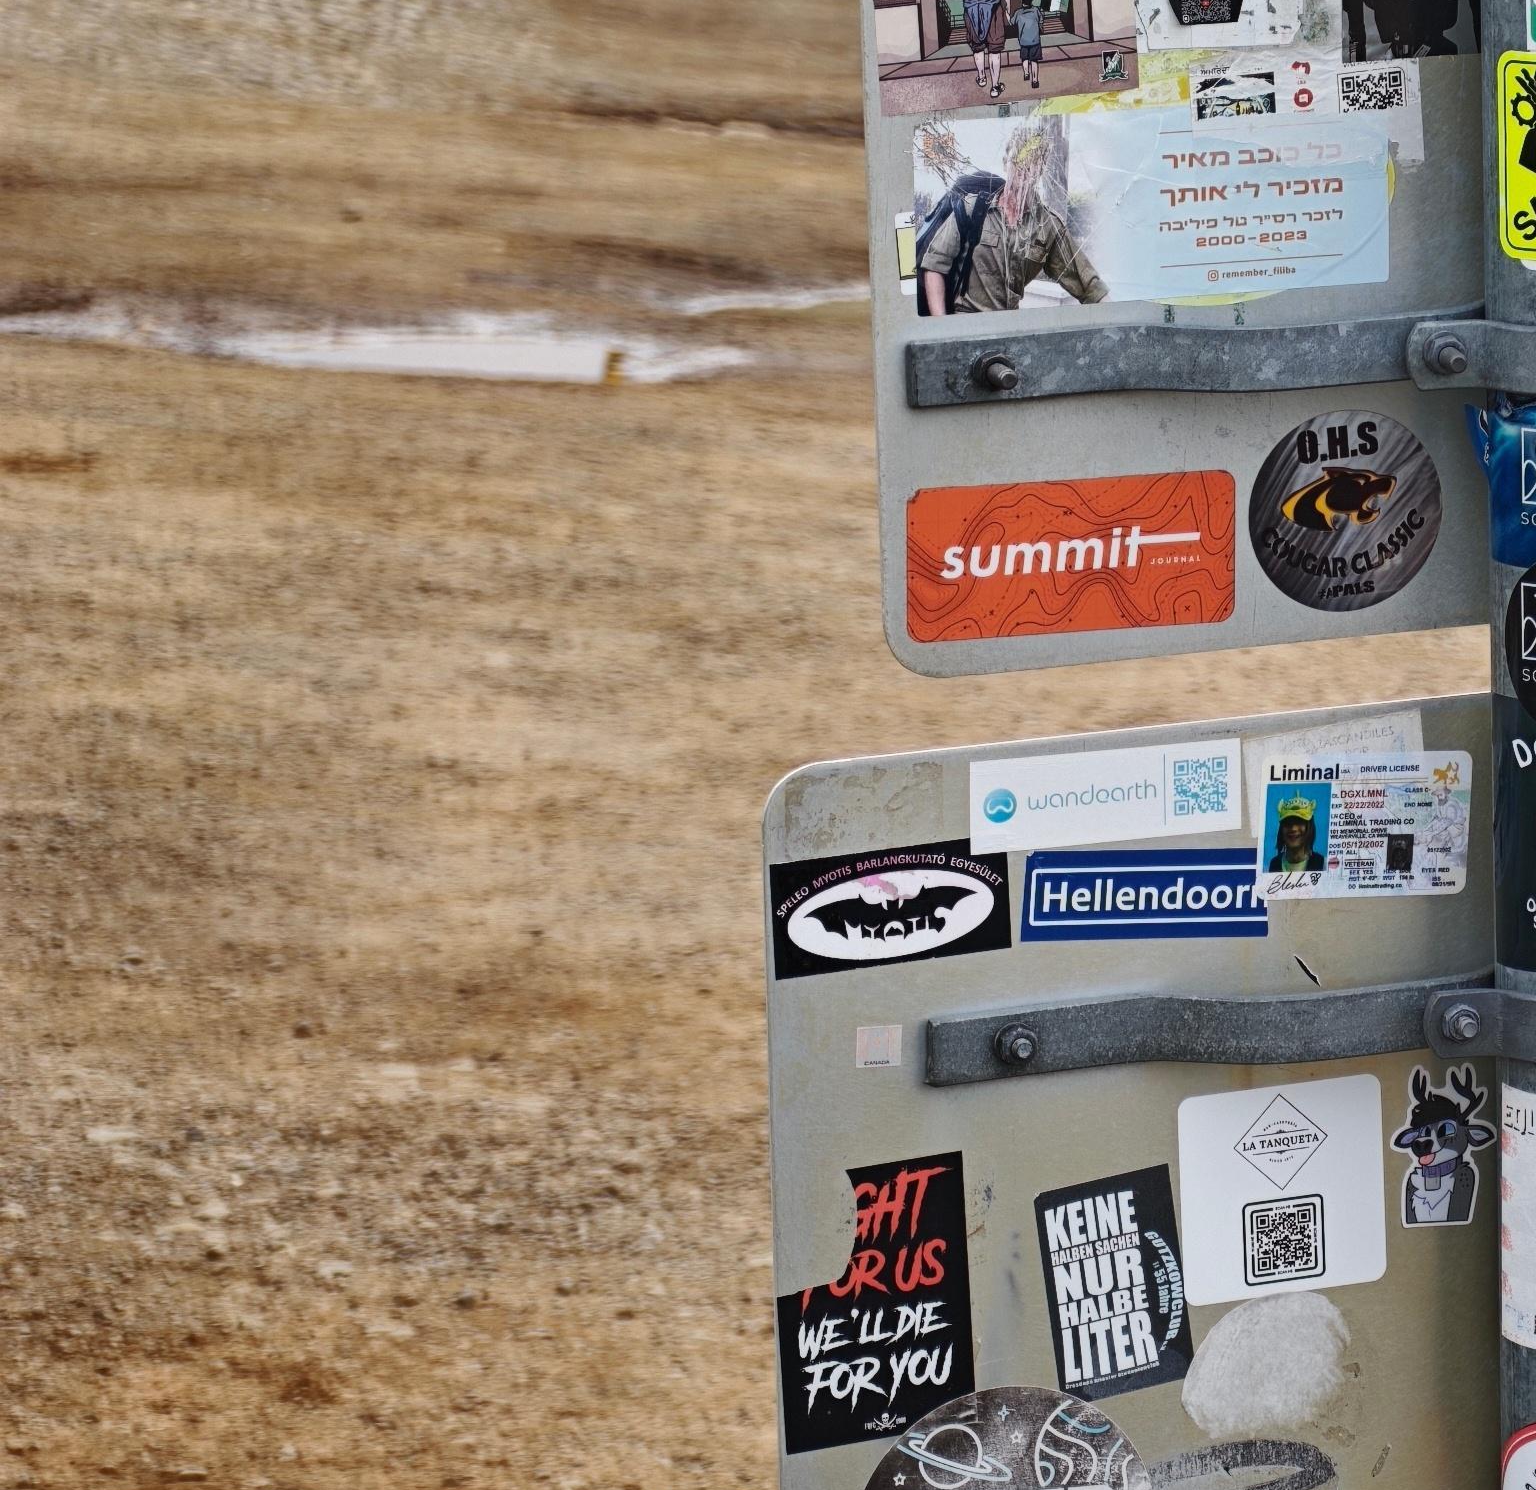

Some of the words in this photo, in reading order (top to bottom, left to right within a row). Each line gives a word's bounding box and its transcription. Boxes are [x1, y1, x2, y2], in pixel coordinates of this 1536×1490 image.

[1162, 150, 1231, 170] מאיר
[1160, 184, 1228, 207] אותך
[1267, 177, 1344, 196] מזכיר
[1301, 208, 1343, 222] לזכר
[1297, 420, 1379, 465] O.H.S
[939, 525, 1201, 580] summit
[1150, 554, 1201, 566] JOURNAL
[1262, 525, 1349, 578] COUGAR
[1351, 507, 1425, 575] CLASSIC
[1027, 779, 1158, 811] wandearth
[1270, 763, 1340, 782] Liminal
[1389, 764, 1420, 772] LICENSE
[776, 886, 810, 919] SPELEO
[812, 865, 852, 889] MYOTIS
[856, 852, 946, 873] BARLANGKUTATÓ
[950, 857, 1004, 887] EGYESÜLET
[1242, 1141, 1257, 1152] LA
[1259, 1132, 1320, 1150] TANQUETA
[1044, 1190, 1140, 1253] KEINE
[896, 1239, 948, 1292] US
[1051, 1244, 1095, 1267] HALBEN
[1095, 1231, 1141, 1256] SACHEN
[1052, 1247, 1146, 1305] NUR
[1144, 1231, 1185, 1341] GUTZKOWCLUB
[886, 1301, 953, 1347] DIE
[1058, 1284, 1150, 1329] HALBE
[1061, 1309, 1160, 1384] LITER
[801, 1355, 889, 1416] FOR
[888, 1342, 954, 1408] YOU
